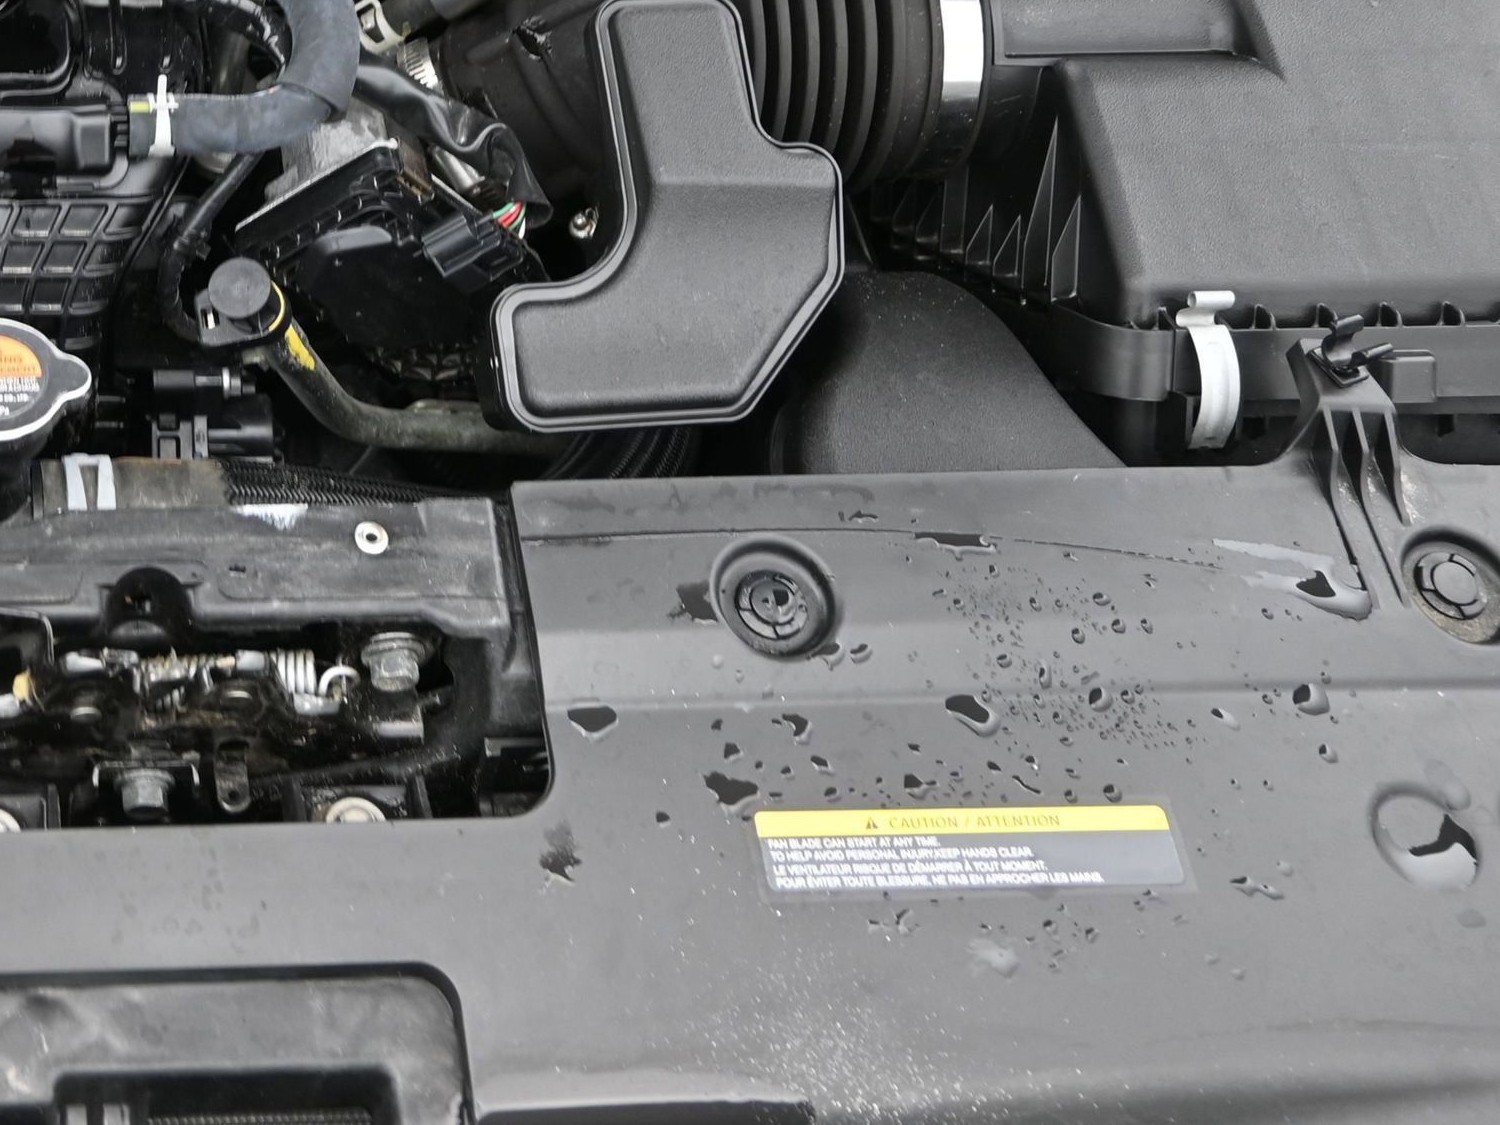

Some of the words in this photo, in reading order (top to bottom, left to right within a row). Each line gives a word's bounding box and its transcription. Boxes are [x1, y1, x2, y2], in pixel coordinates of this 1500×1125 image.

[889, 817, 958, 829] CAUTION
[977, 815, 1061, 828] ATTENTION
[767, 838, 788, 849] FAN
[789, 837, 823, 849] BLADE
[823, 837, 846, 849] CAN
[846, 836, 877, 848] START
[879, 836, 891, 848] AT
[893, 836, 914, 847] ANY
[770, 850, 785, 862] TO
[785, 850, 812, 862] HELP
[813, 849, 844, 861] AVOID
[845, 848, 900, 861] PERSONAL
[960, 846, 998, 859] HANDS
[772, 864, 787, 876] LE
[787, 863, 853, 876] VENTILATEUR
[852, 862, 891, 875] RISQUE
[891, 862, 907, 874] DE
[907, 859, 964, 874] DÉMARRER
[973, 861, 1000, 873] TOUT
[775, 876, 806, 889] POUR
[806, 875, 842, 889] ÉVITER
[842, 876, 876, 888] TOUTE
[931, 874, 948, 886] NE
[947, 874, 970, 885] PAS
[970, 873, 985, 885] EN
[985, 872, 1050, 885] APPROCHER
[1049, 872, 1069, 884] LES
